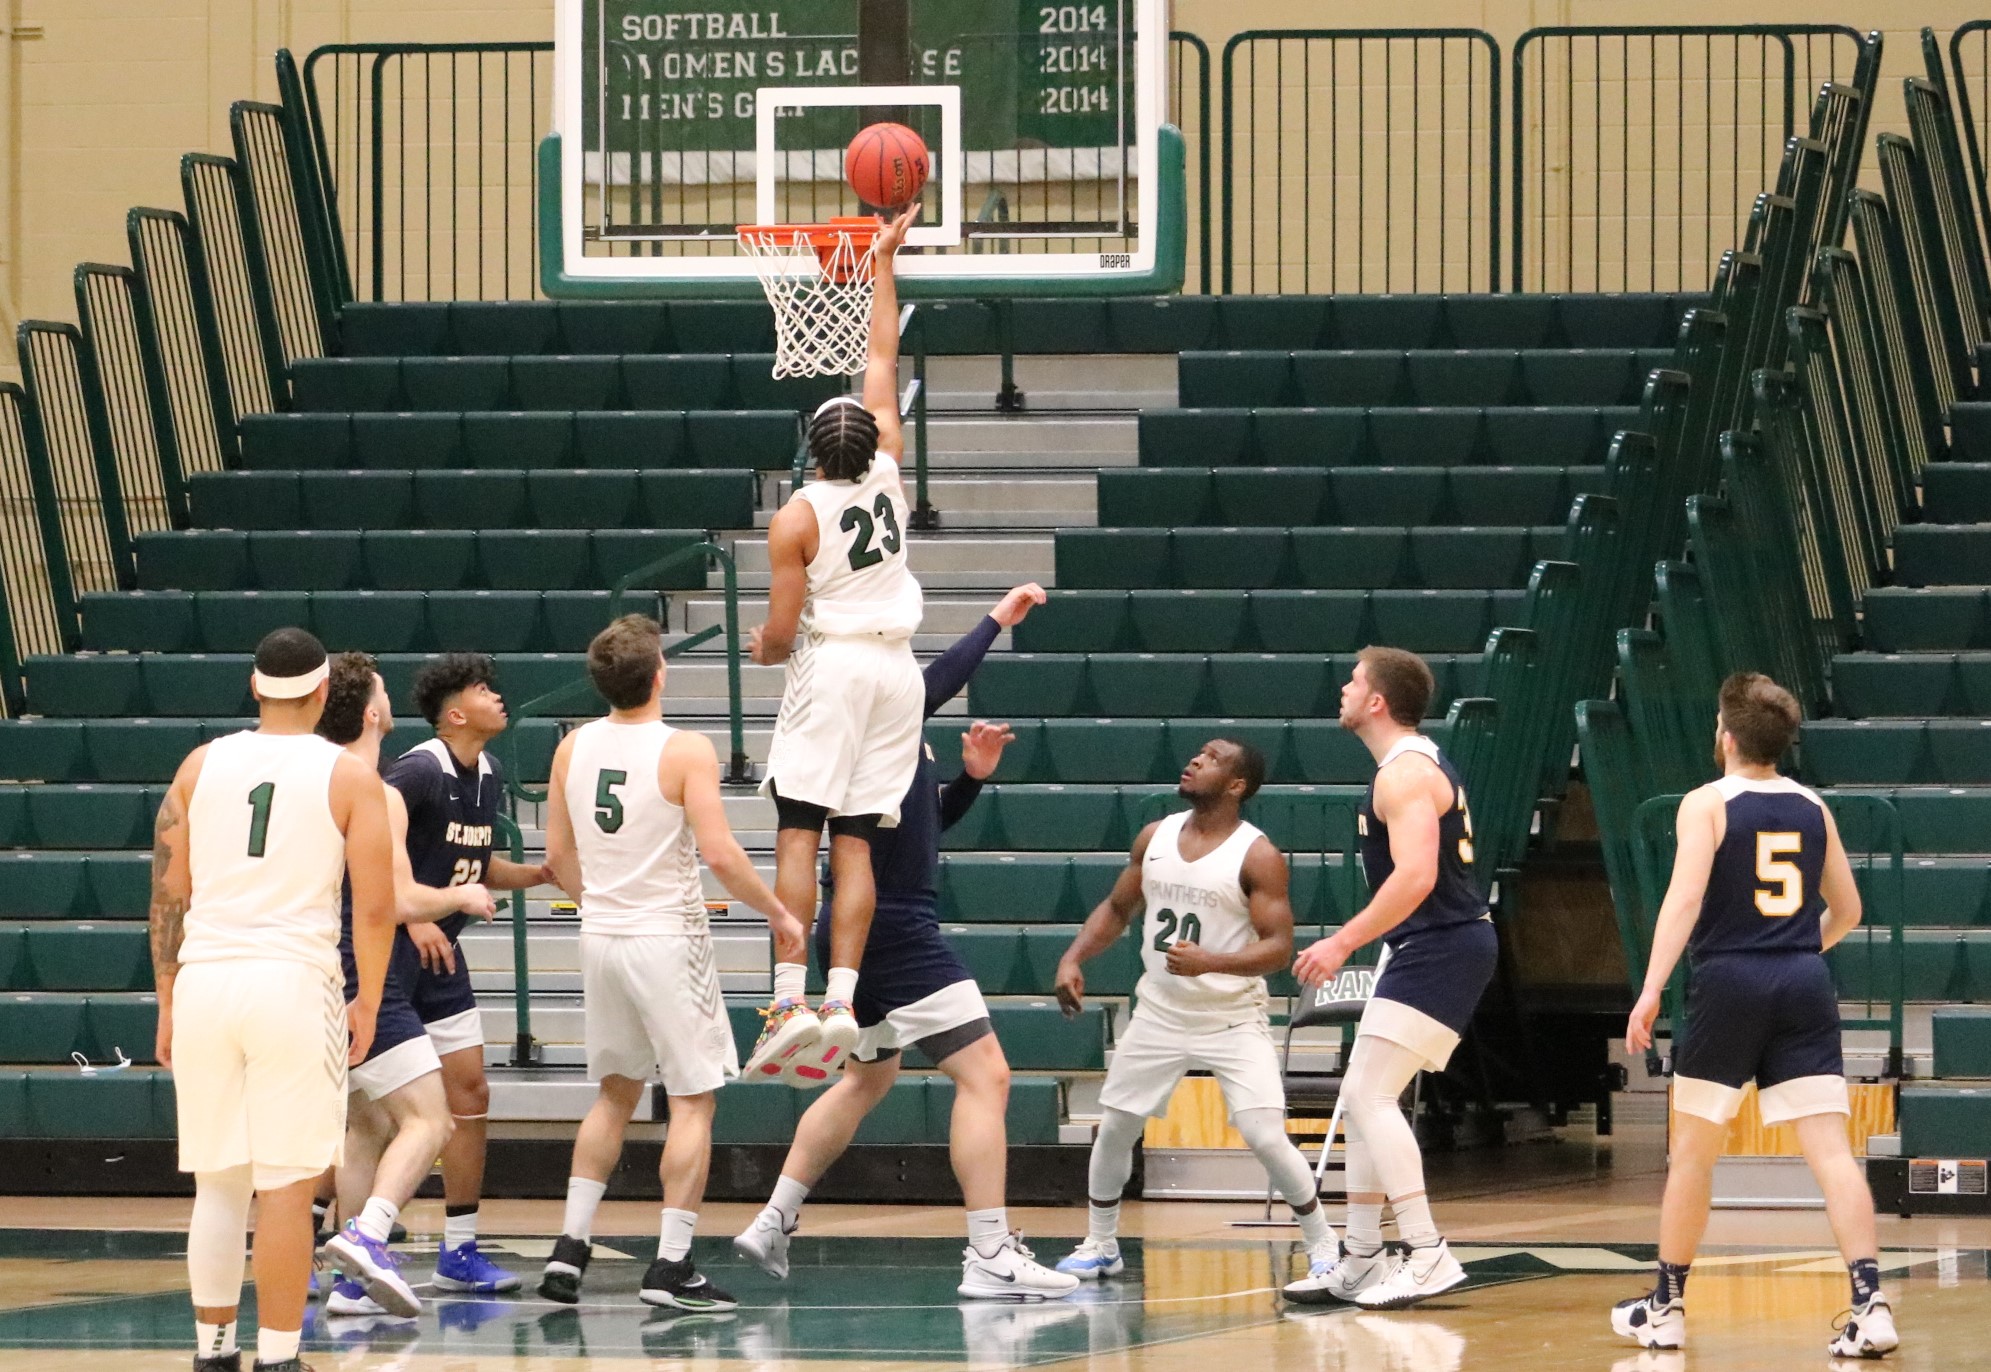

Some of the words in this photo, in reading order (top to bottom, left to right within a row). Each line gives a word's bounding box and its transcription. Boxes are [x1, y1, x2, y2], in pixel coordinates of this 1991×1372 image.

[622, 13, 787, 41] SOFTBALL
[1040, 5, 1106, 33] 2014
[622, 51, 784, 80] OMENS
[796, 50, 961, 78] LACSE
[1040, 45, 1106, 73] 2014
[622, 92, 723, 120] MEN'S
[1040, 85, 1108, 114] 2014
[840, 492, 900, 571] 23
[248, 782, 275, 858] 1
[595, 768, 627, 834] 5
[449, 858, 482, 887] 22
[1754, 831, 1803, 917] 5
[1151, 880, 1218, 908] PANTHERS
[1154, 908, 1201, 953] 20
